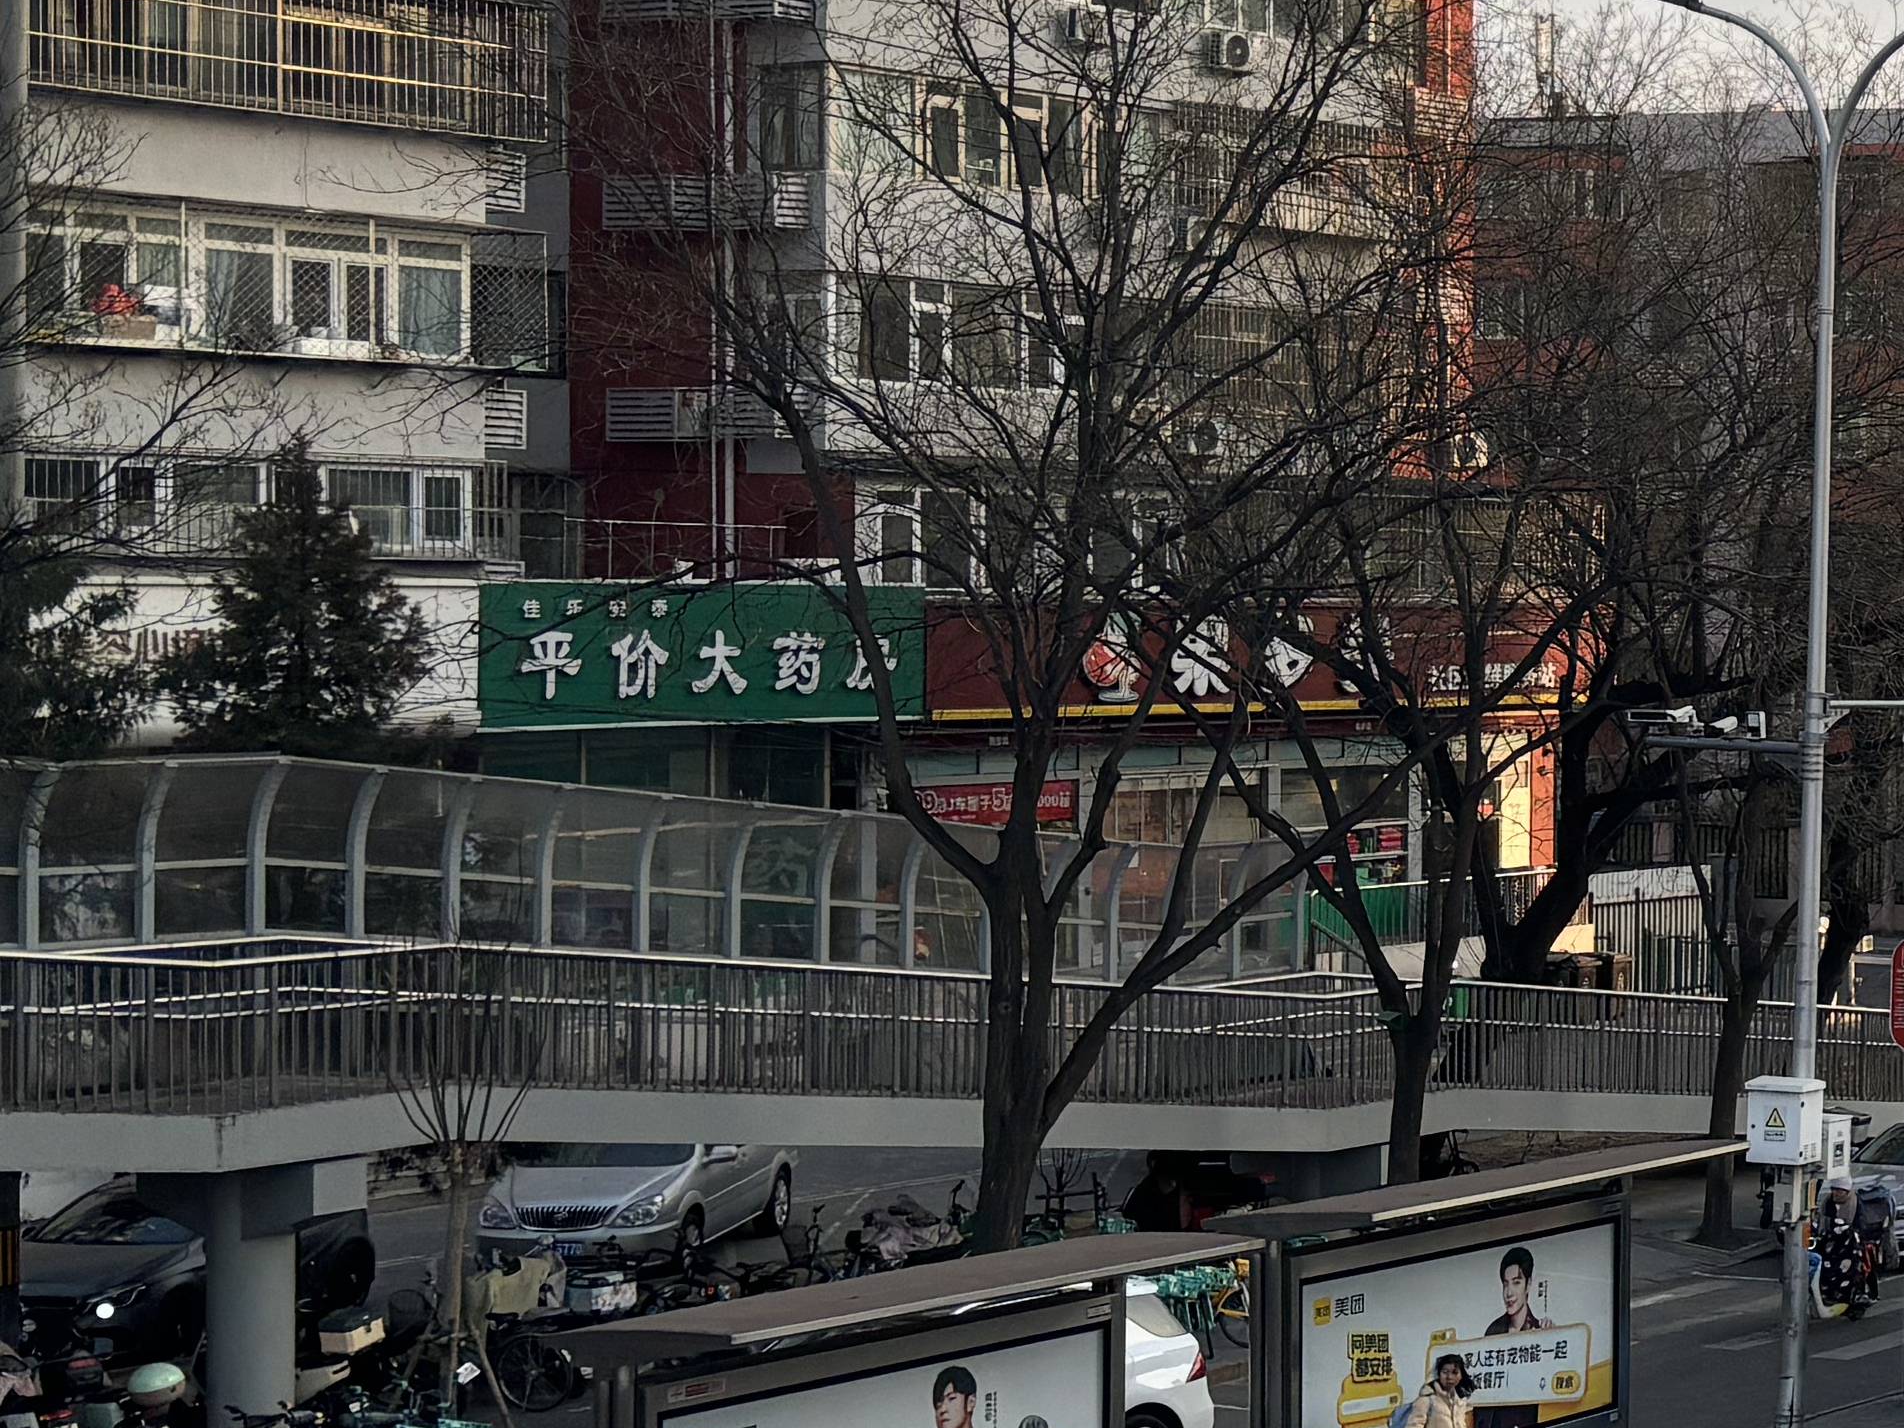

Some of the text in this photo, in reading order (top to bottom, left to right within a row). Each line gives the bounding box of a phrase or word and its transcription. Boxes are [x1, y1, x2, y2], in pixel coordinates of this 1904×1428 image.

[1334, 1293, 1365, 1319] 美团
[1462, 1339, 1568, 1370] 家人还有宠物能一起
